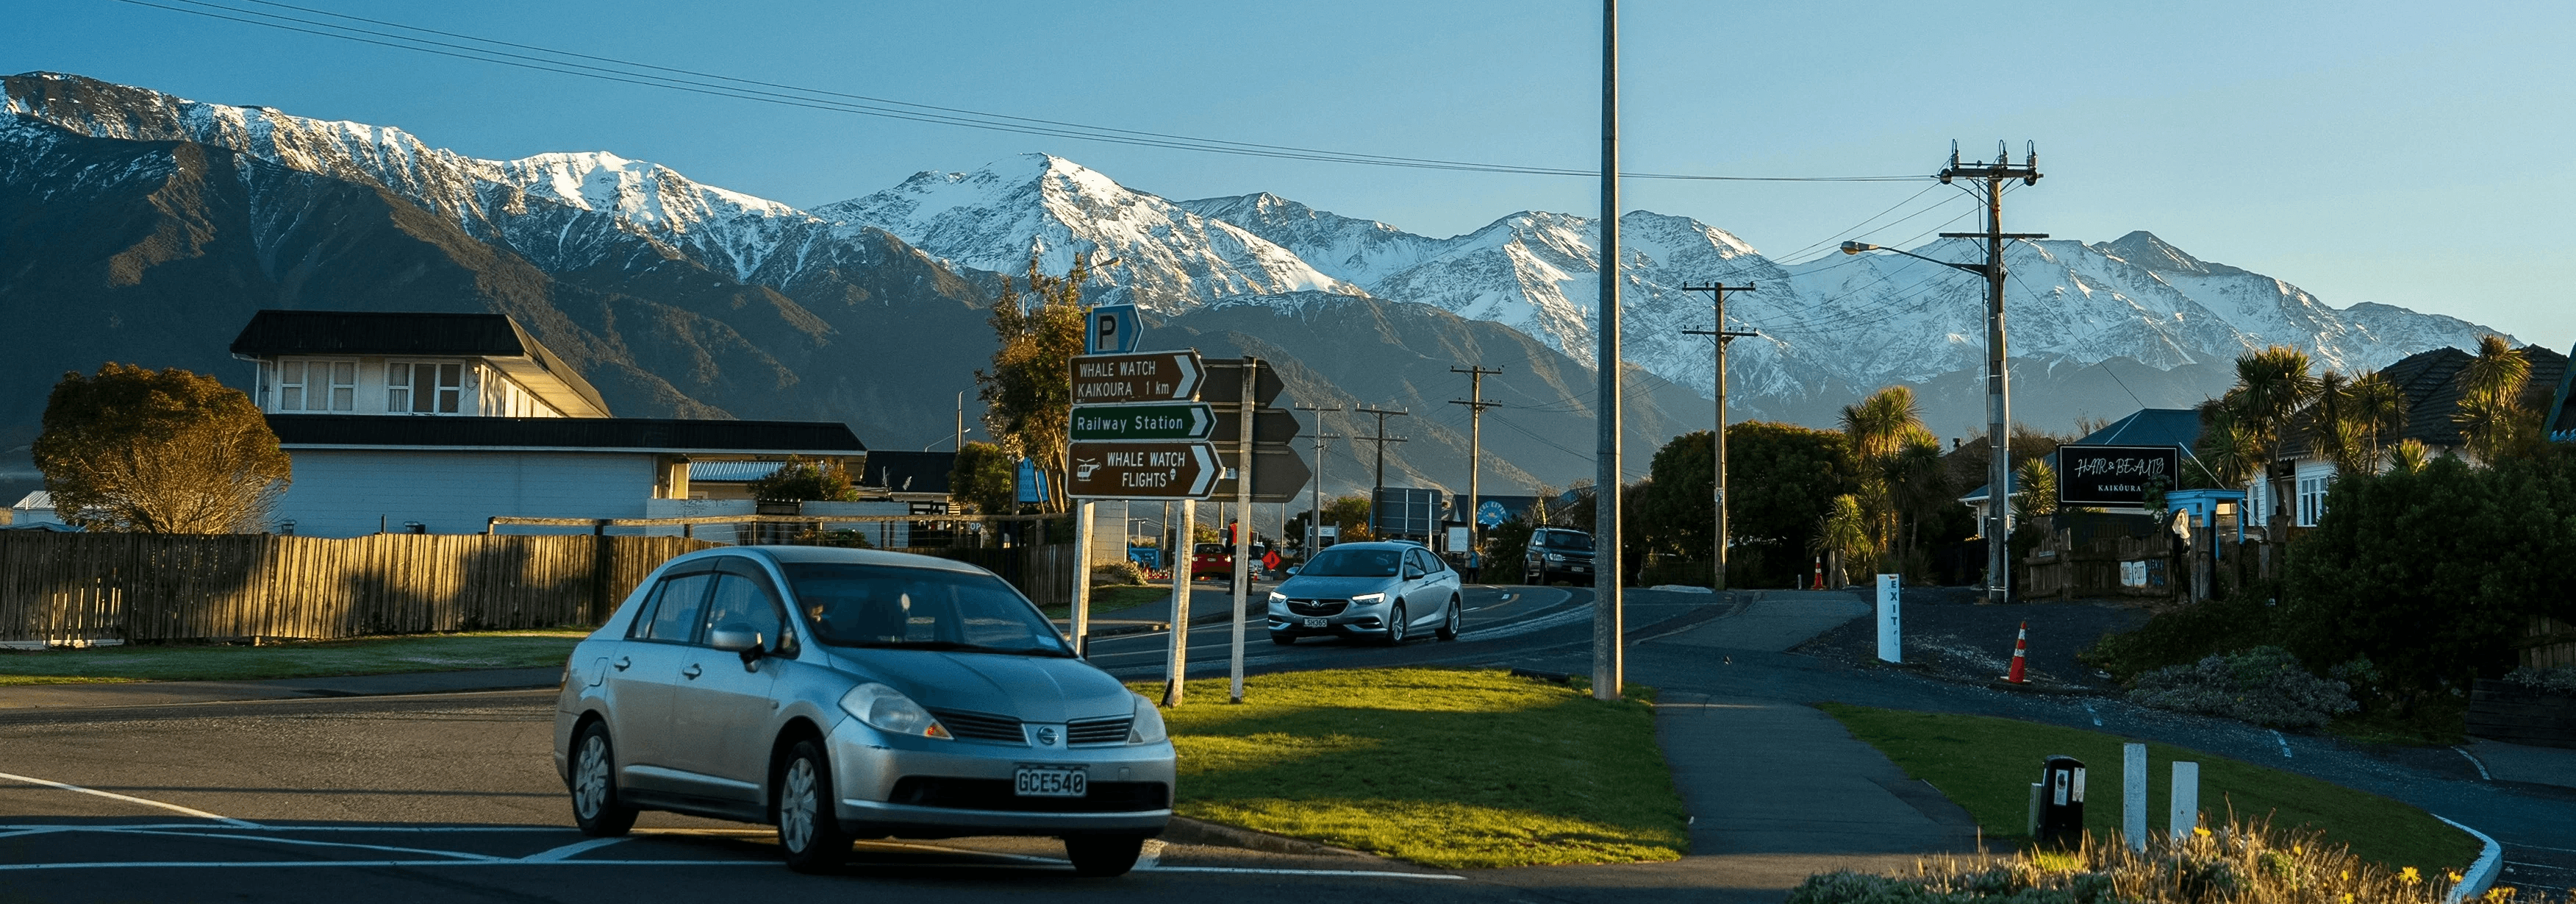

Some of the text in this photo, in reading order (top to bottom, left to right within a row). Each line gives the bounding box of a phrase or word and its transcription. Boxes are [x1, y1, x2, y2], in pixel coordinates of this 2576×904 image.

[1098, 315, 1116, 349] P
[1079, 360, 1156, 377] WHALE WATCH
[1078, 381, 1170, 397] KAIKOURA 1 km
[1077, 415, 1183, 433] Railway Station
[1107, 452, 1186, 467] WHALE WATCH
[2075, 458, 2164, 477] HAIR & BEAUTY
[1122, 472, 1167, 488] FLIGHTS
[1890, 580, 1898, 625] EXIT
[1018, 772, 1084, 793] GCE540
